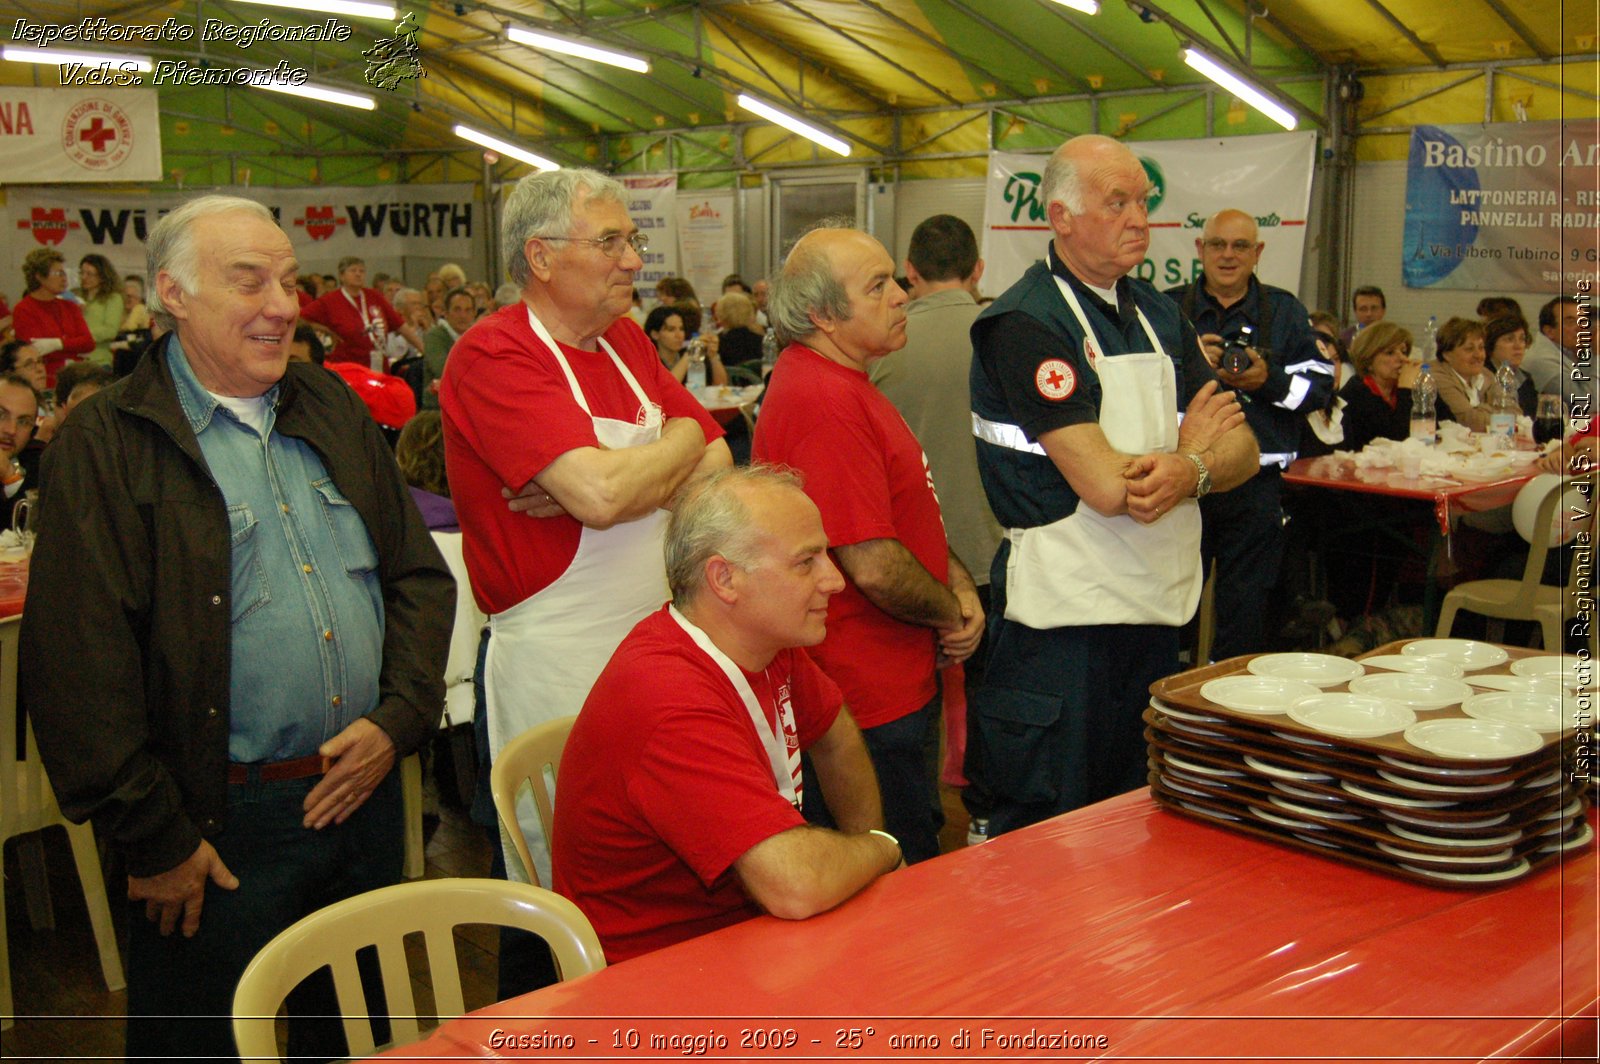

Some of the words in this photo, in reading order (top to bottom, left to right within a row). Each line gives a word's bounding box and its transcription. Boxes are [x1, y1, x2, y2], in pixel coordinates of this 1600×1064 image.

[1424, 138, 1546, 168] Bastino
[1450, 190, 1557, 206] LATTONERIA
[346, 202, 472, 238] WÜRTH
[1460, 210, 1543, 227] PANNELLI
[1431, 244, 1451, 257] Via
[1457, 244, 1502, 259] Libero
[1570, 248, 1579, 262] 9
